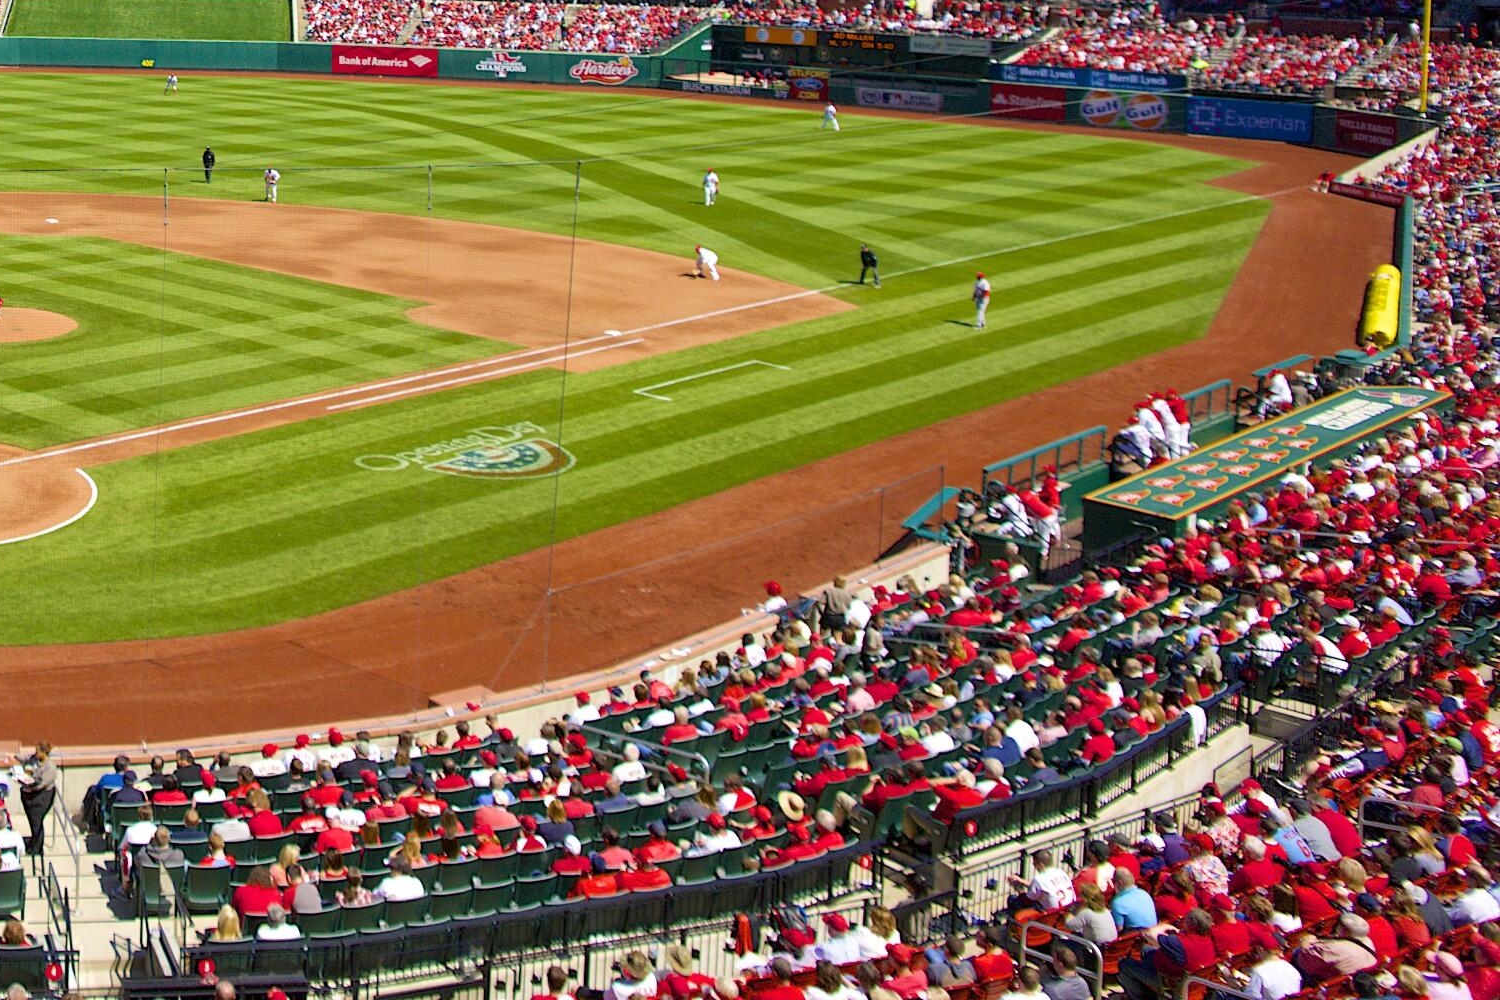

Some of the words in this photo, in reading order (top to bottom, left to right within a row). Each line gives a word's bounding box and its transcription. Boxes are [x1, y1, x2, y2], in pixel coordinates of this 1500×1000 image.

[338, 55, 360, 66] Bank
[361, 56, 370, 66] of
[372, 57, 408, 68] America
[475, 63, 527, 73] CHAMPIONS
[1020, 67, 1048, 77] Merrill
[1050, 69, 1076, 80] Lynch
[1109, 73, 1137, 83] Merrill
[1140, 75, 1168, 87] Lynch
[682, 81, 712, 93] BUSCH
[713, 83, 751, 97] STADIUM
[1083, 100, 1119, 115] Gulf
[1126, 102, 1163, 119] Gulf
[1224, 109, 1306, 132] Experian
[1339, 118, 1366, 130] WELLS
[1367, 122, 1394, 134] FARGO
[1352, 133, 1394, 147] ADVISORS
